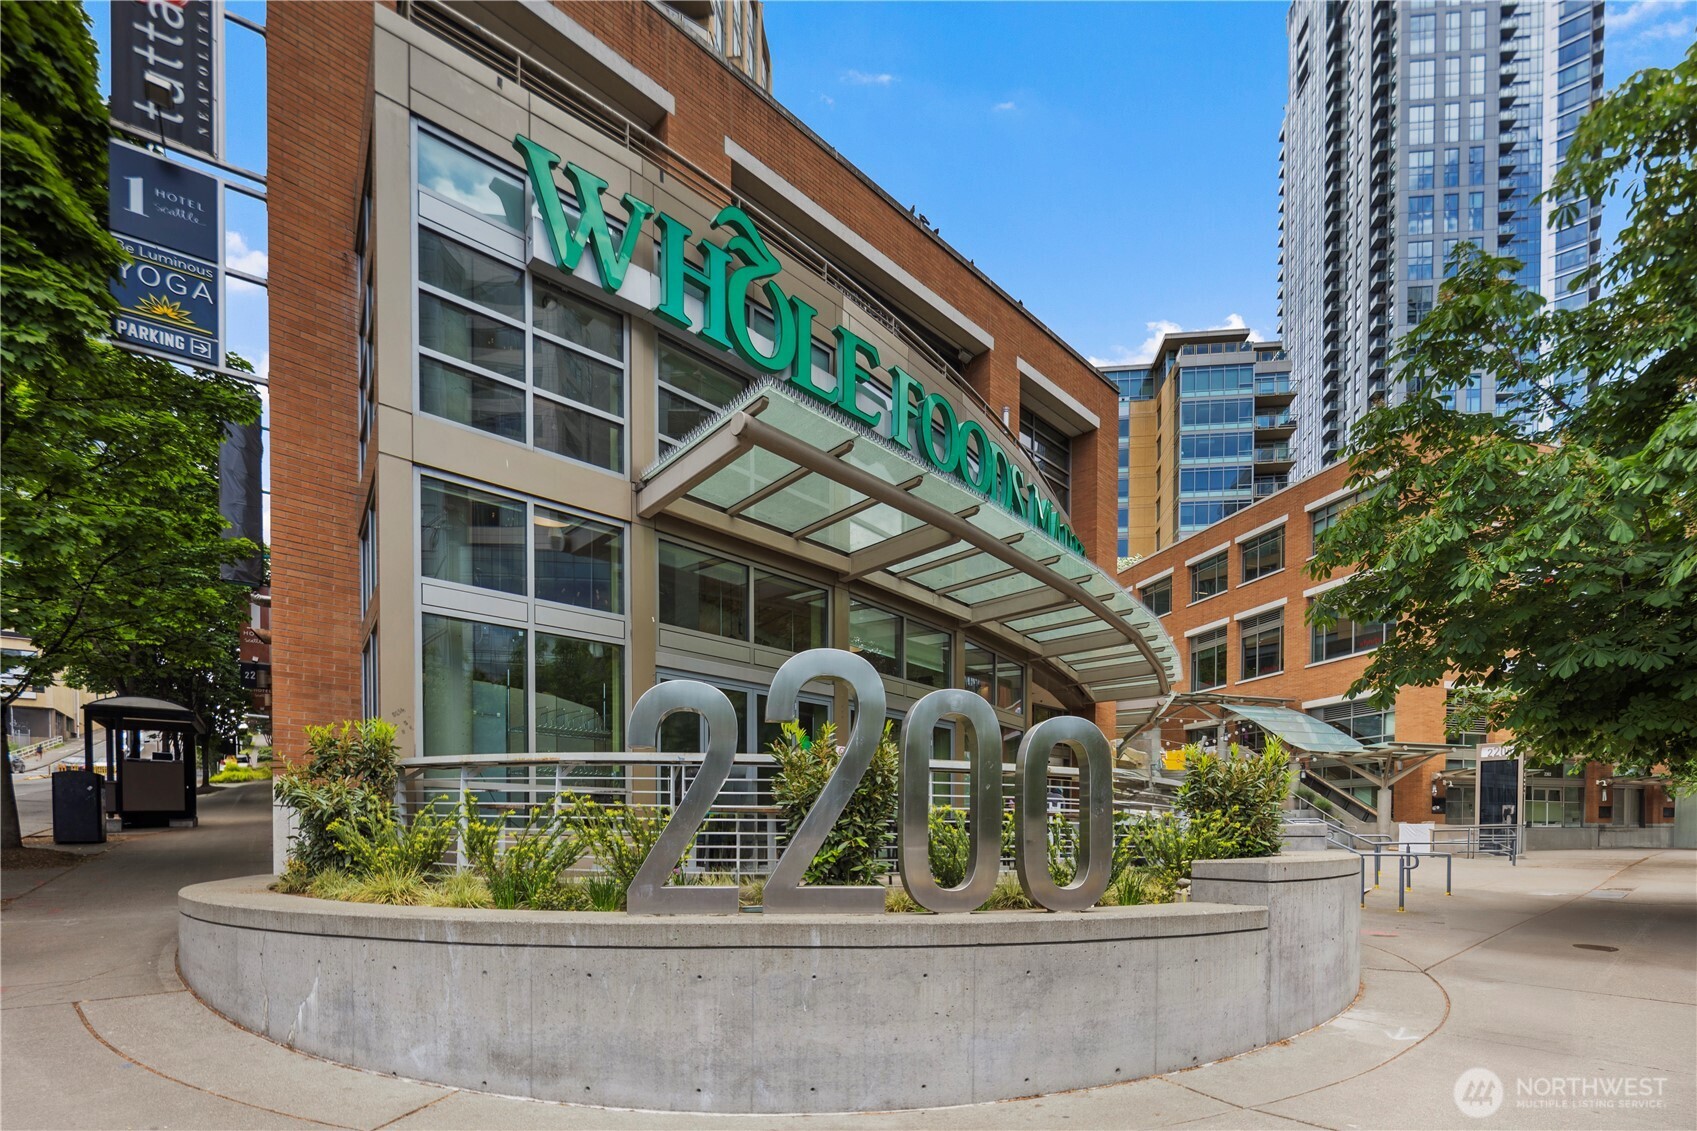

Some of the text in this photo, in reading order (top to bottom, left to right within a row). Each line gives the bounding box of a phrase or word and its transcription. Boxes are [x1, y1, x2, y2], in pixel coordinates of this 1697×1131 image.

[197, 0, 209, 137] NEAPOLITA
[123, 176, 206, 218] 1 HOTEL
[139, 244, 214, 279] Luminous
[120, 262, 214, 305] YOGA
[116, 318, 186, 351] PARKING
[513, 133, 881, 427] WHOLE
[889, 364, 1027, 519] FOODS
[627, 648, 1113, 915] 2200
